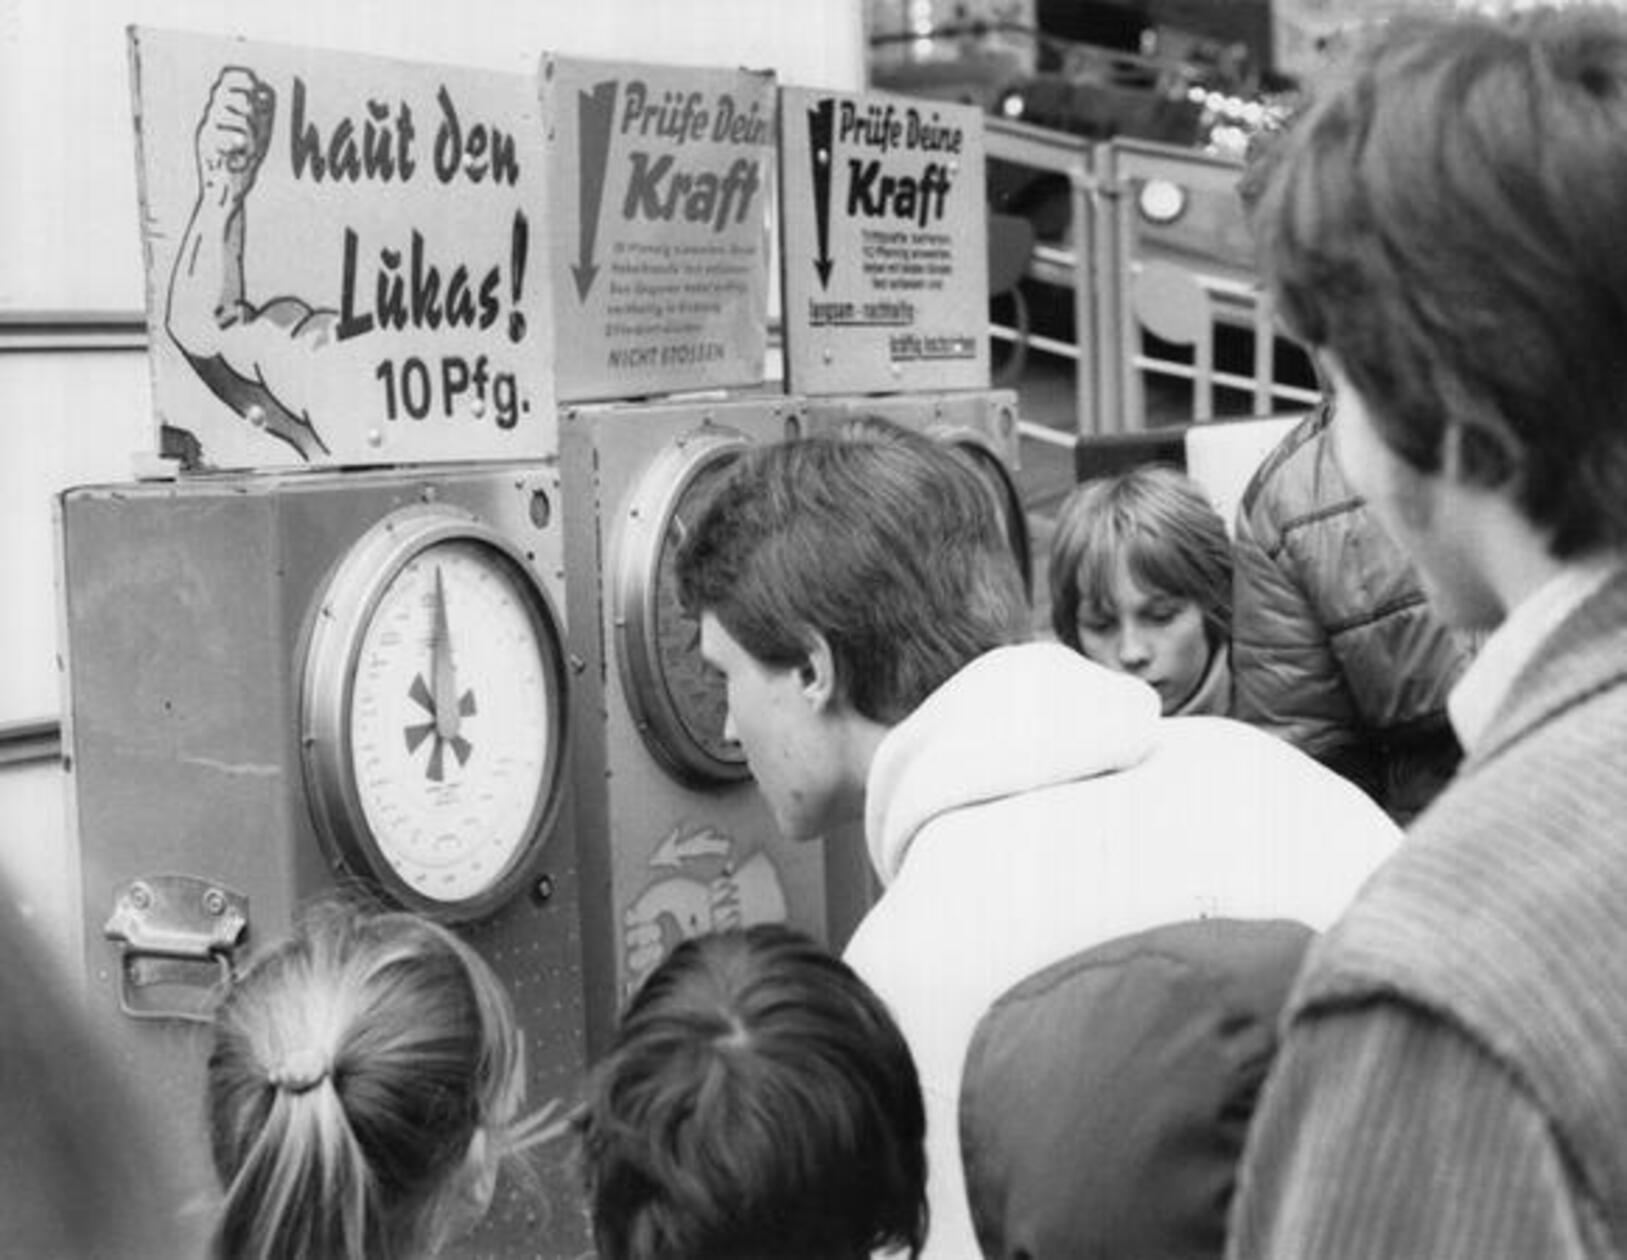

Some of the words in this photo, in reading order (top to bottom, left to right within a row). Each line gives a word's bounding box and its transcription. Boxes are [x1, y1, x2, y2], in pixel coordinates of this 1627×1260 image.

[434, 84, 519, 186] den
[620, 80, 709, 145] Prüfe
[839, 100, 903, 153] Prüfe
[906, 107, 963, 154] Deine
[622, 151, 760, 233] Kraft
[846, 158, 951, 228] Kraft
[376, 357, 432, 421] 10
[441, 355, 530, 429] Pfg.
